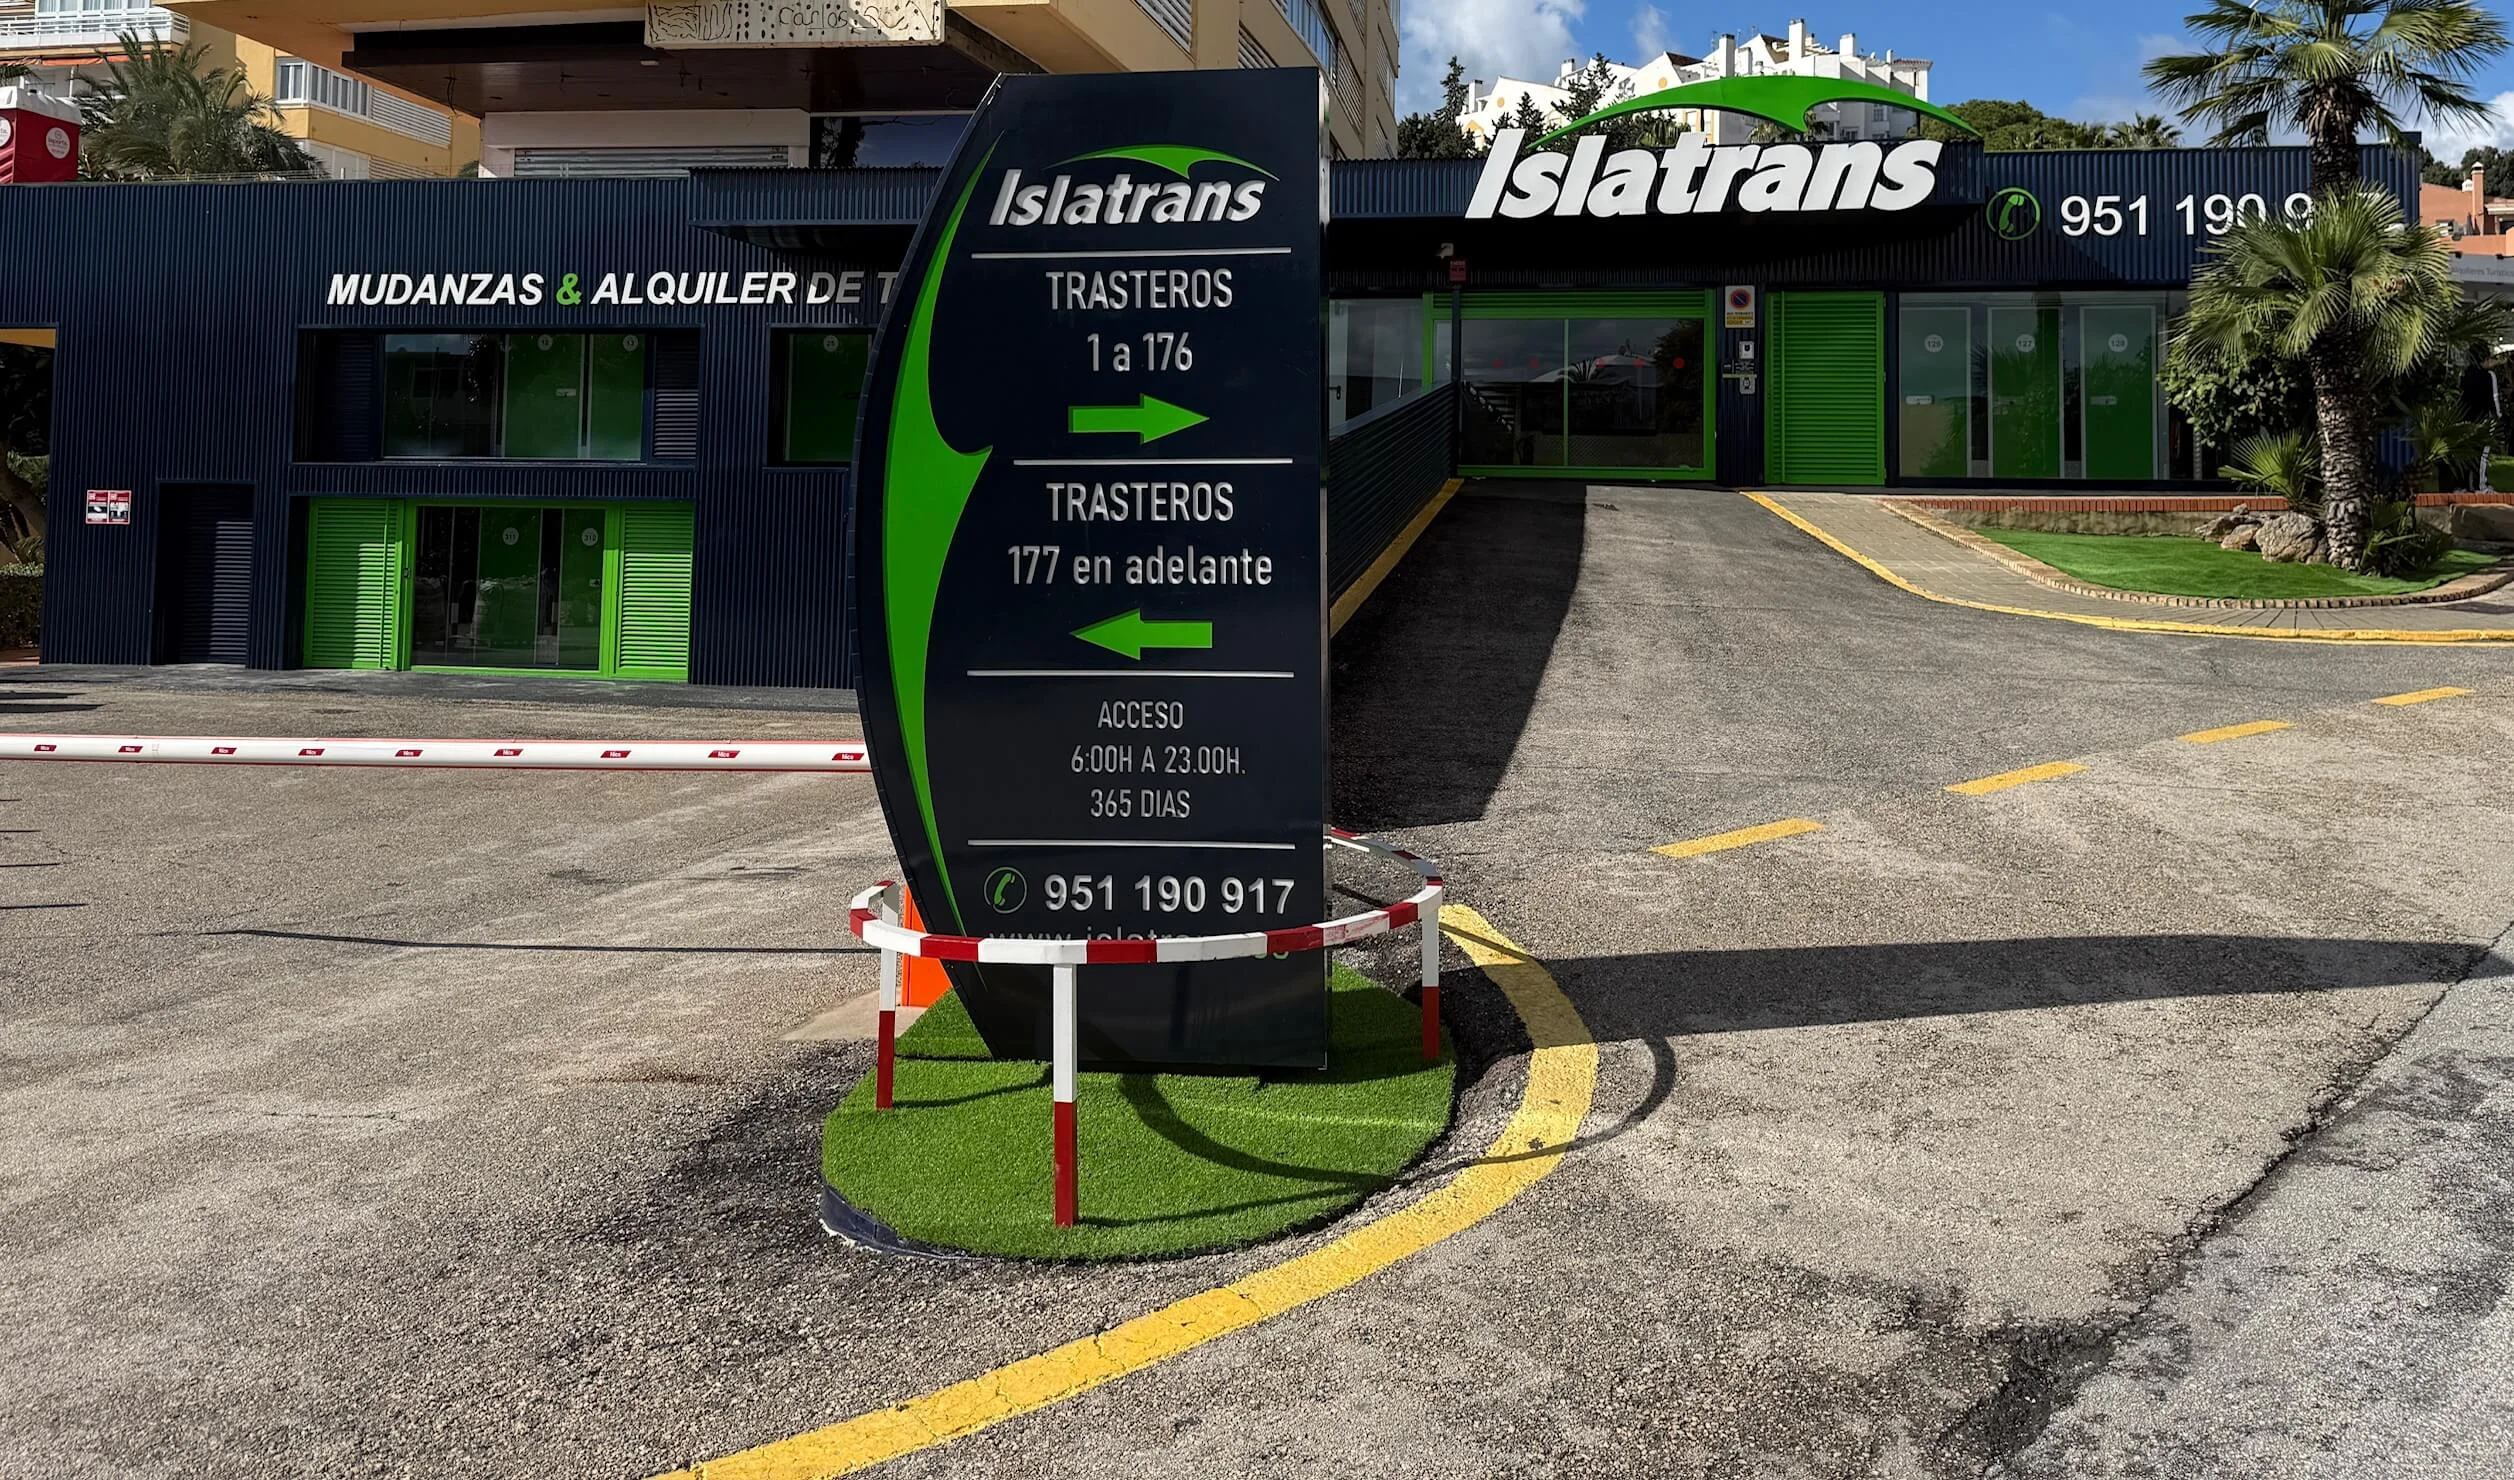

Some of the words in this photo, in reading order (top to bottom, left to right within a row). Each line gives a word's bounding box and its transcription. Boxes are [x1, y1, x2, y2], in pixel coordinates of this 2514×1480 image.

[1464, 128, 1944, 219] Islatrans
[989, 168, 1267, 226] Islatrans
[2060, 195, 2148, 236] 951
[2175, 193, 2267, 236] 190
[326, 272, 545, 306] MUDANZAS
[555, 272, 582, 306] &
[590, 271, 798, 306] ALQUILER
[806, 271, 865, 305] DE
[1045, 268, 1234, 310] TRASTEROS
[1087, 333, 1100, 372] 1
[1113, 343, 1131, 372] a
[1142, 331, 1194, 372] 176
[1046, 481, 1234, 522] TRASTEROS
[1008, 545, 1061, 585] 177
[1073, 555, 1112, 586] en
[1125, 545, 1273, 586] adelante
[1097, 700, 1184, 730] ACCESO
[1071, 744, 1132, 774] 6:00H
[1141, 745, 1156, 774] A
[1164, 745, 1246, 776] 23.00H.
[1090, 788, 1132, 818] 365
[1141, 789, 1191, 819] DIAS
[1044, 874, 1114, 911] 951
[1134, 875, 1206, 913] 190
[1221, 877, 1296, 915] 917
